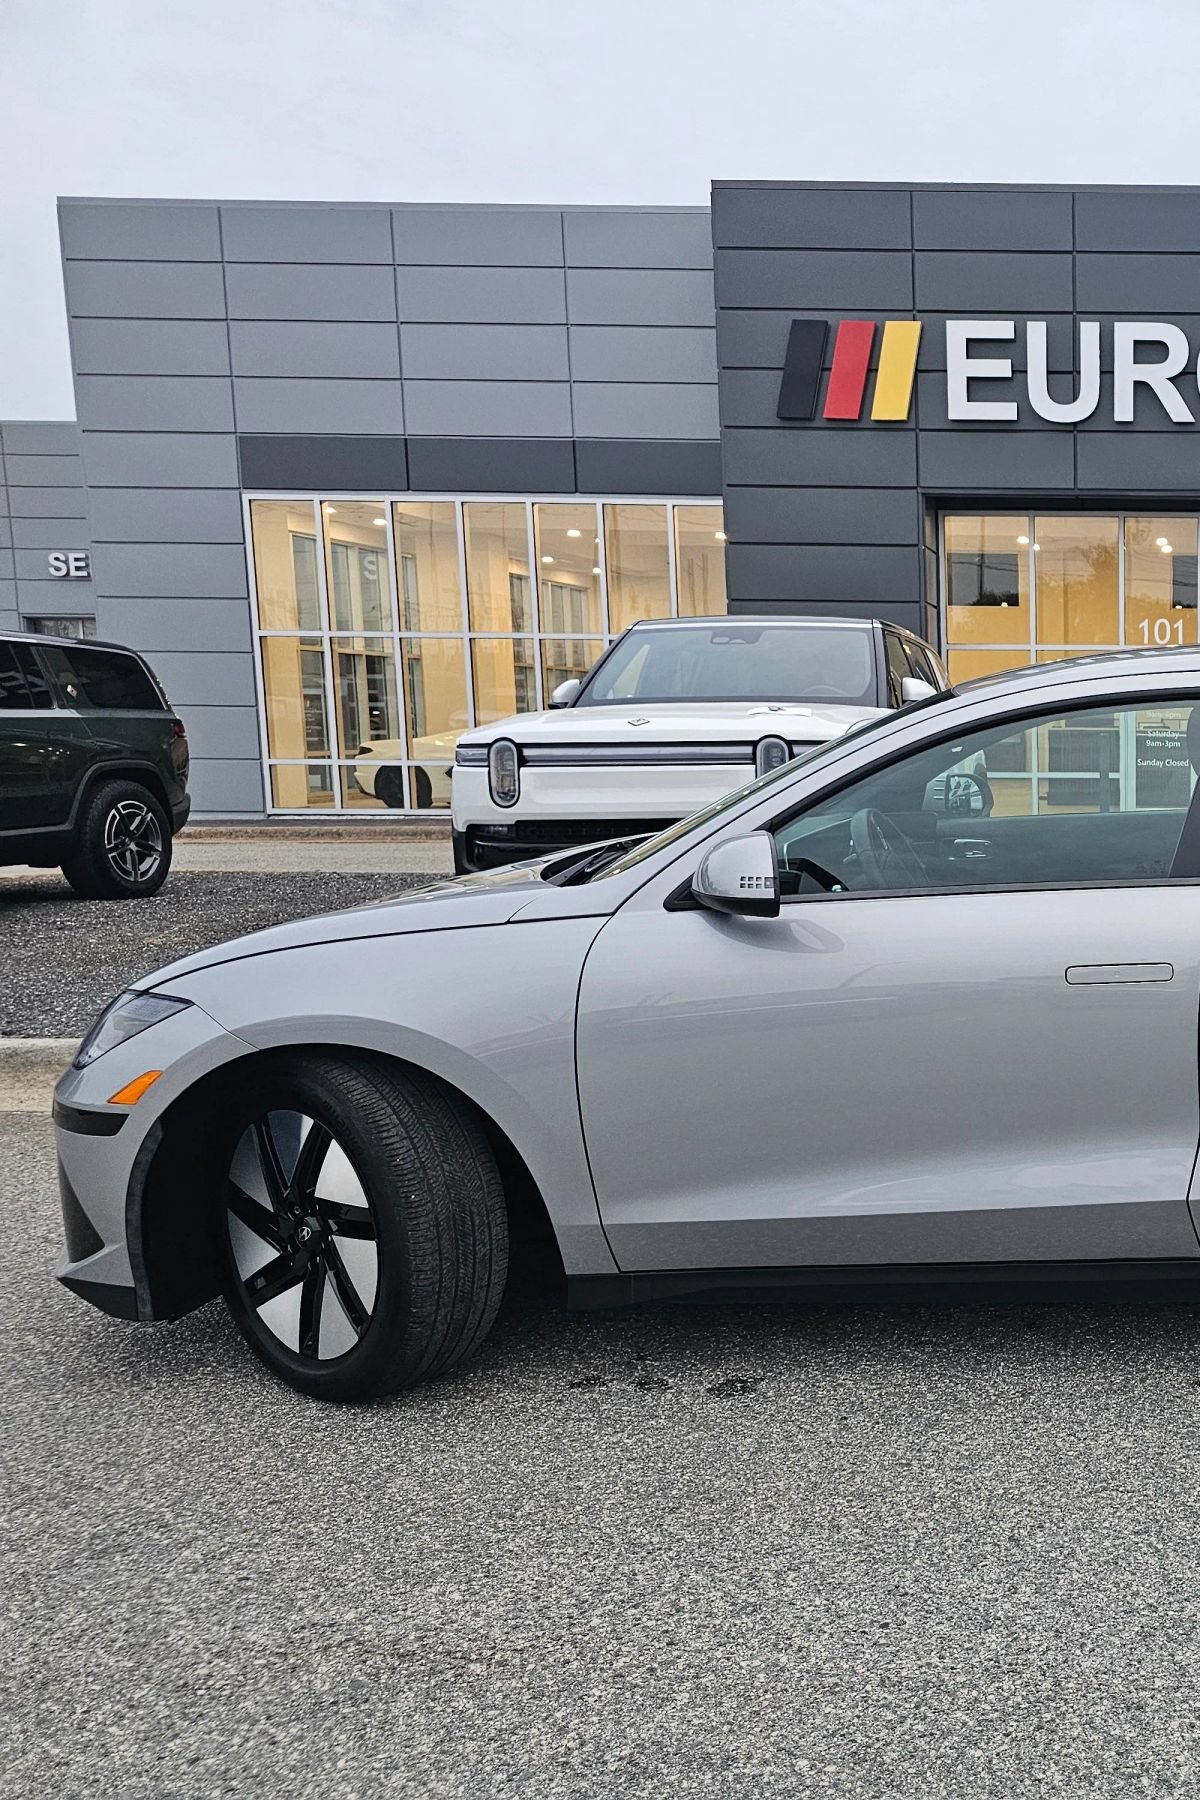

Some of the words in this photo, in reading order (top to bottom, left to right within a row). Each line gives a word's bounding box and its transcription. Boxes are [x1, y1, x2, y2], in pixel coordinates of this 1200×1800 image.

[48, 552, 88, 577] SE
[1138, 618, 1183, 645] 101
[1147, 729, 1180, 739] Saturday
[1145, 739, 1181, 749] 9am-3pm
[1137, 758, 1163, 768] Sunday
[1165, 758, 1189, 767] Closed
